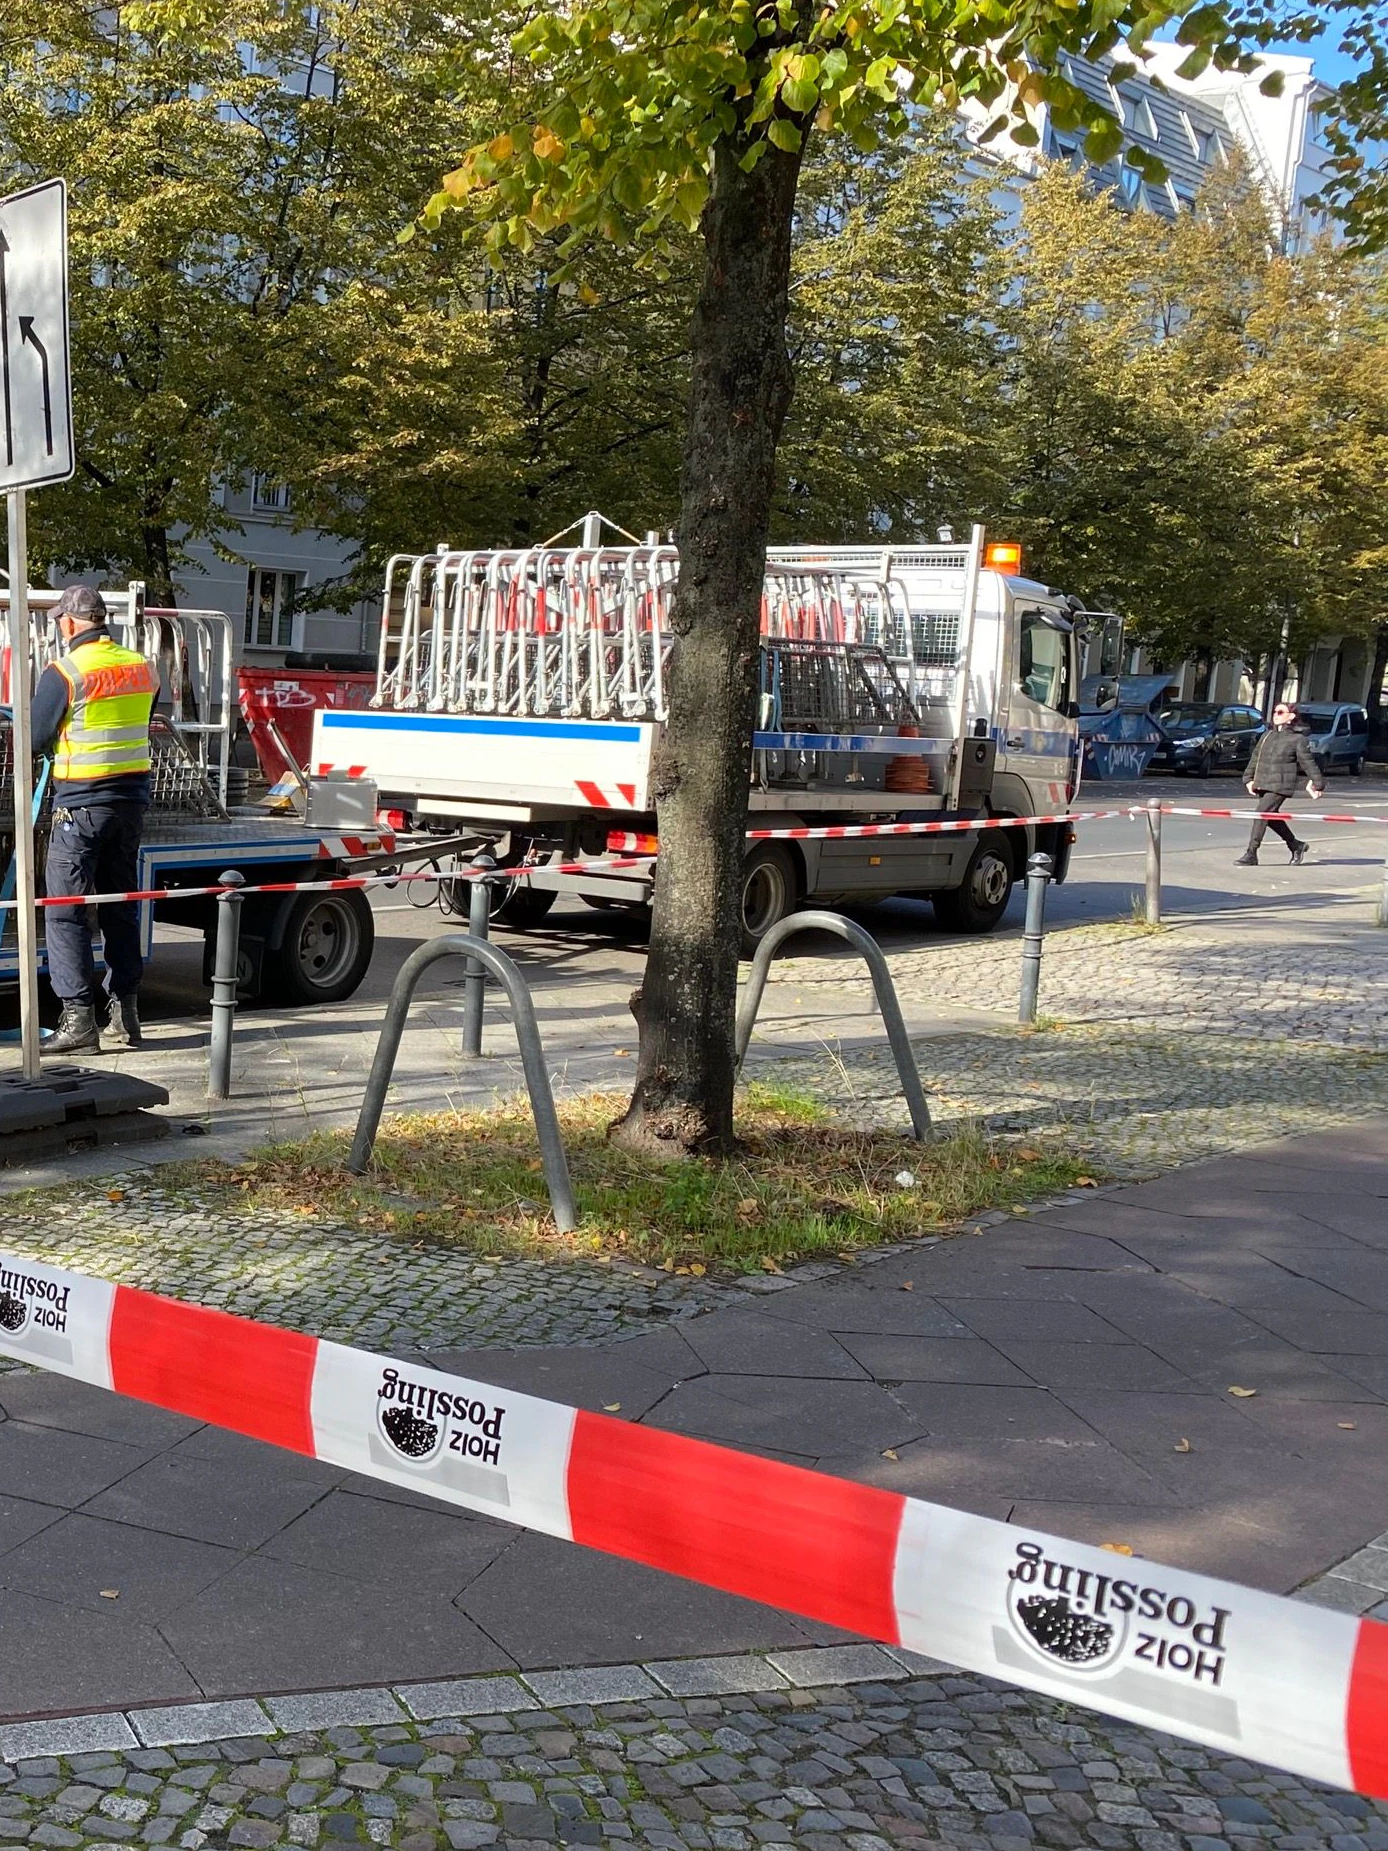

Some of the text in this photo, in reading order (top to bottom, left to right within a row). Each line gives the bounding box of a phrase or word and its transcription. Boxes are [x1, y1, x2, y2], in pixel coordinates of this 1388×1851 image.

[34, 1306, 67, 1333] Holz
[377, 1368, 506, 1441] Possling
[449, 1429, 501, 1466] Holz
[1008, 1542, 1234, 1653] Possling
[1133, 1632, 1226, 1688] Holz
